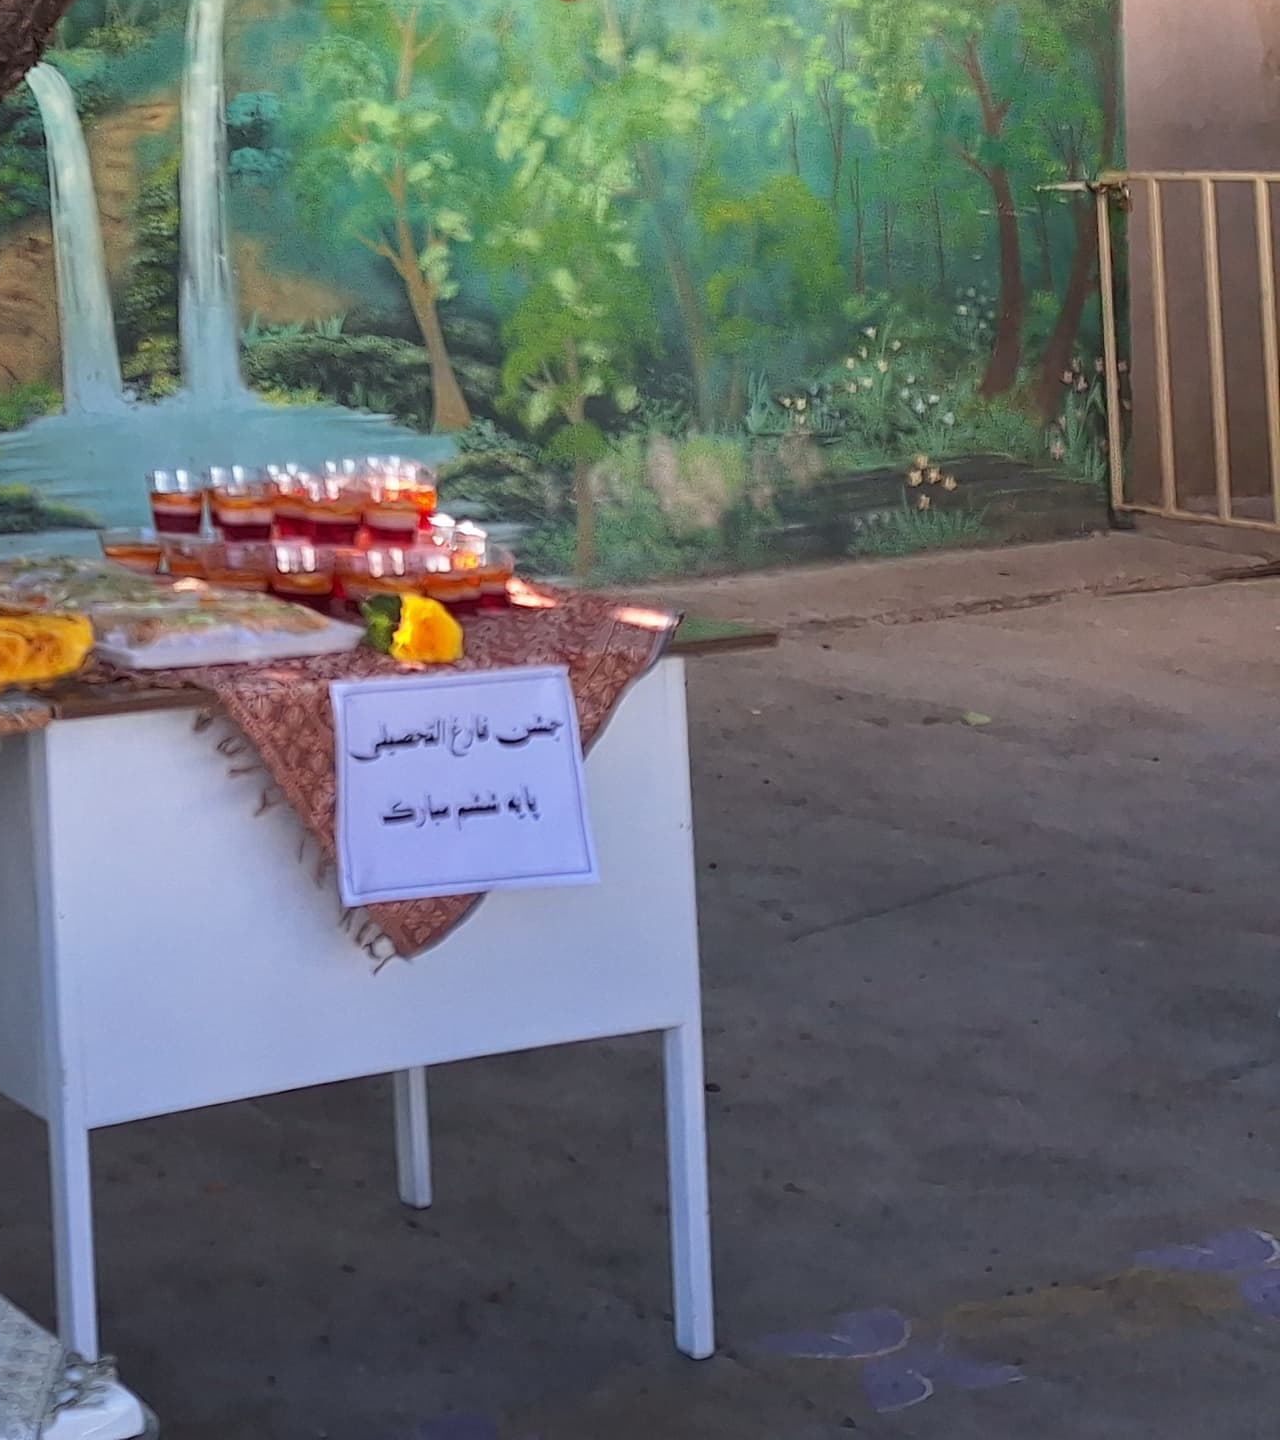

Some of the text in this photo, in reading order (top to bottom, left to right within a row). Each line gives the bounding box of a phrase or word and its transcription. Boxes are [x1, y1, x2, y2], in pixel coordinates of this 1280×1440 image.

[350, 715, 564, 761] جشن فارغ التحصیلی
[382, 786, 541, 832] پایه ششم مبارک
